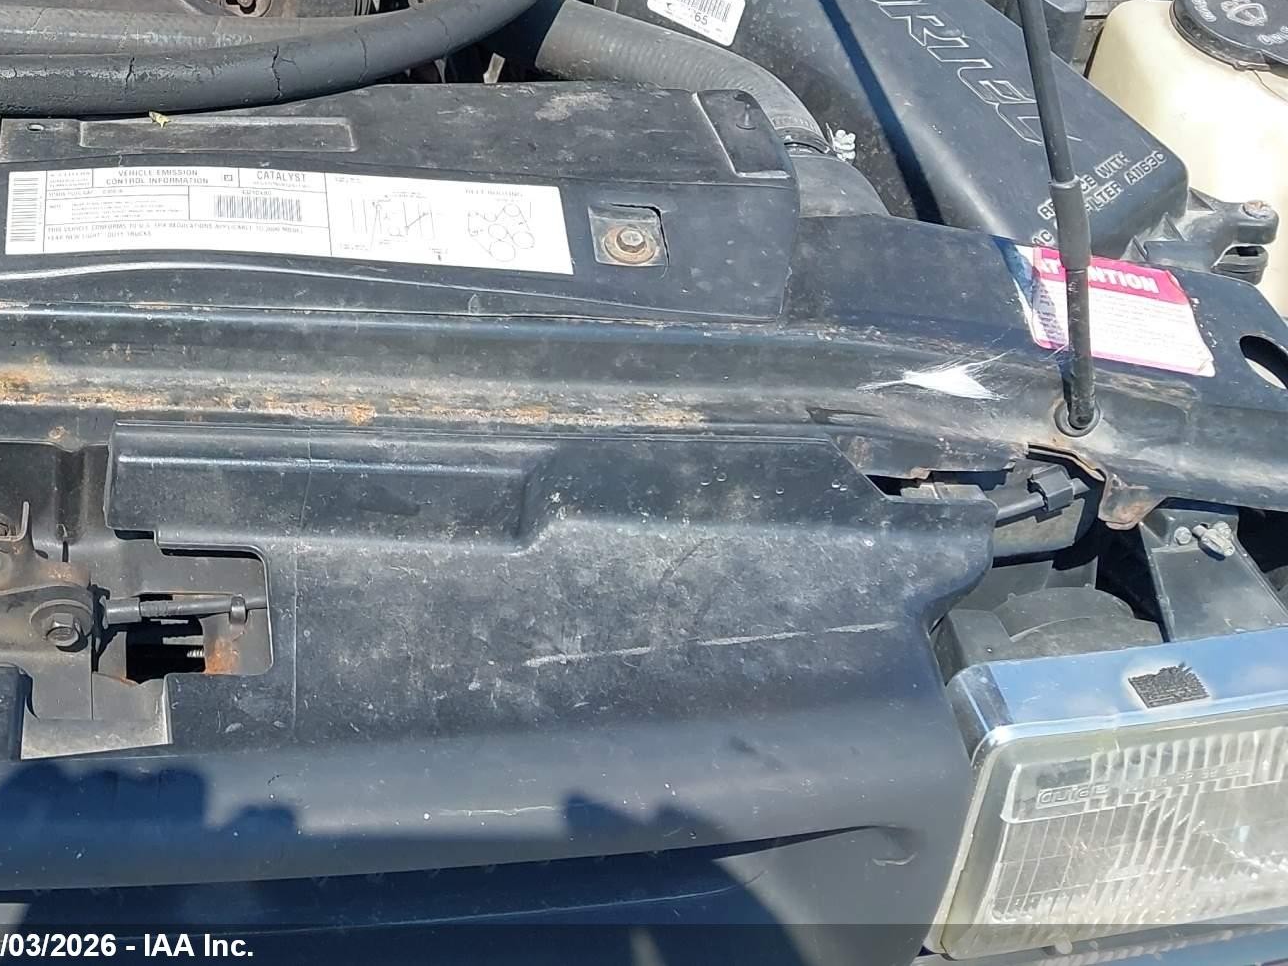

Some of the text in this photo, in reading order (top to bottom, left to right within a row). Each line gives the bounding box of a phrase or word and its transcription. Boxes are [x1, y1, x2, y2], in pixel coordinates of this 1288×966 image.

[118, 169, 198, 177] VEHICLE EMISSION
[256, 170, 307, 183] CATALYST
[106, 176, 209, 185] CONTROL INFORMATION
